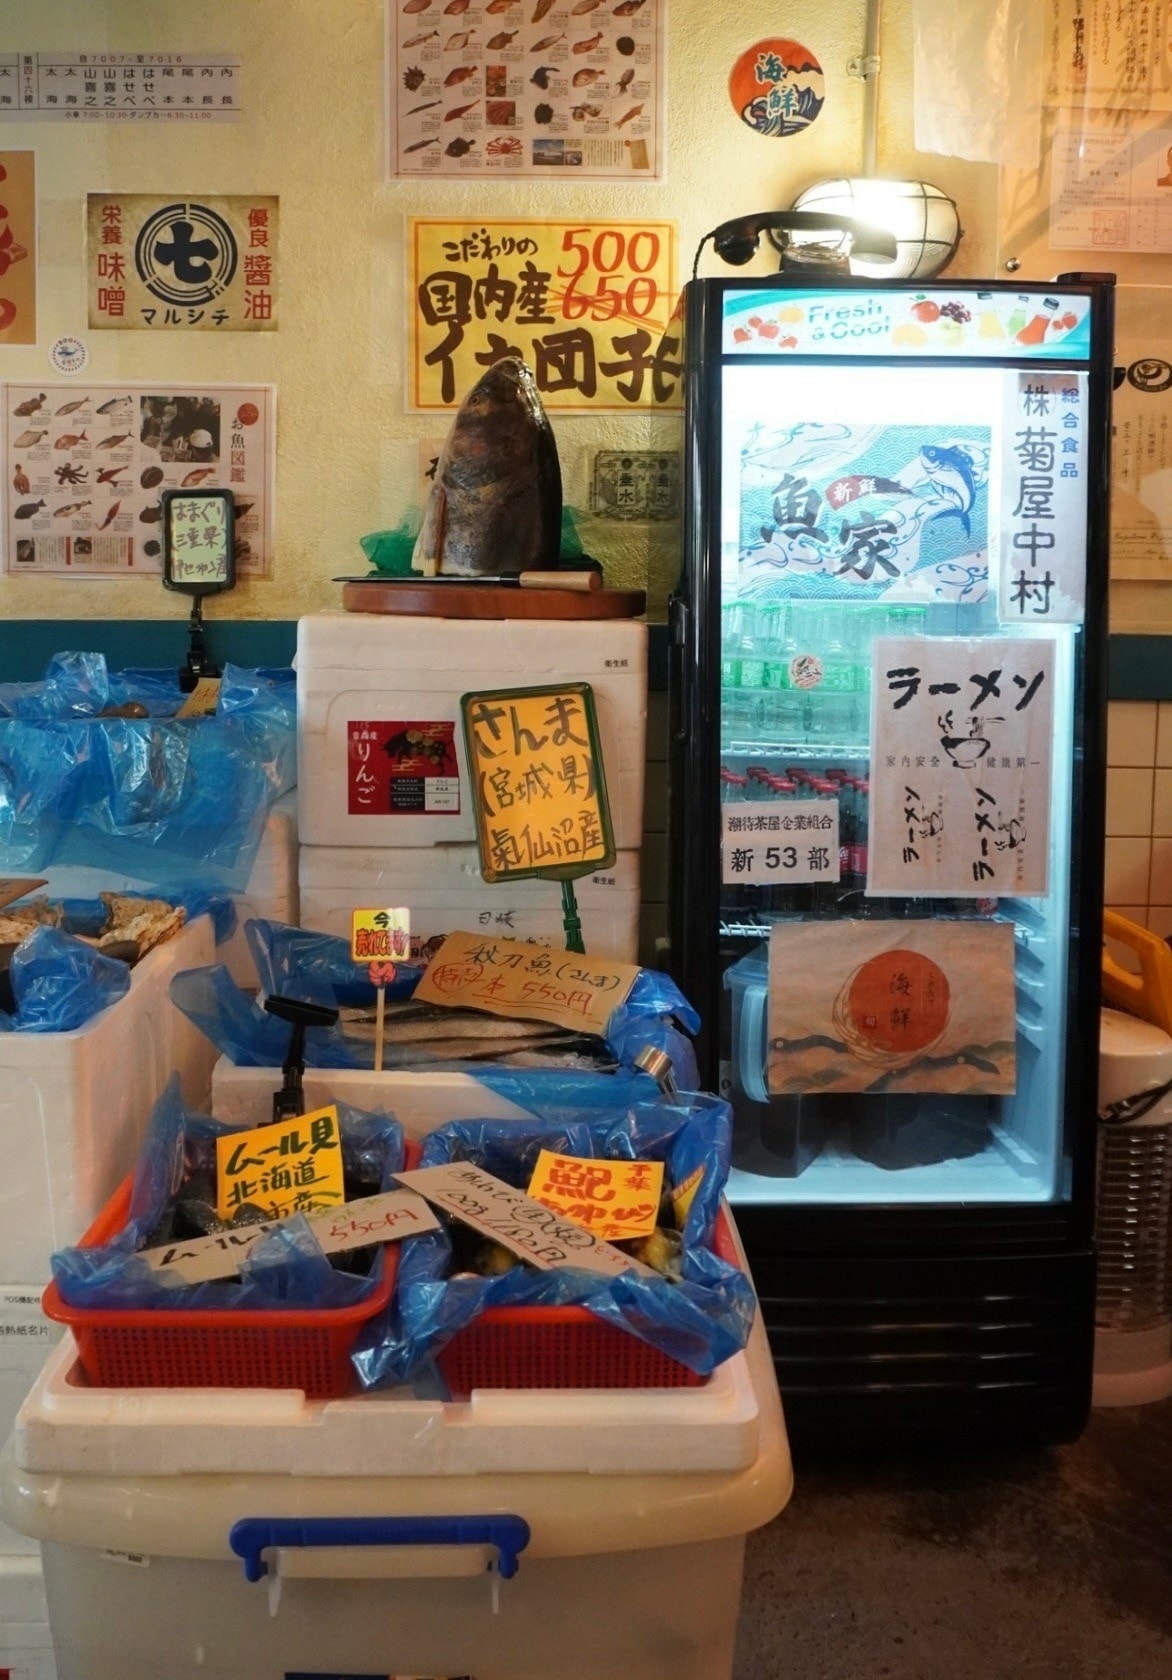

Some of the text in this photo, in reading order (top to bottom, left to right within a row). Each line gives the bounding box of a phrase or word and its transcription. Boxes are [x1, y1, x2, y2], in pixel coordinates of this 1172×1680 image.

[755, 52, 800, 119] 海鮮
[153, 221, 219, 284] 七
[441, 228, 539, 264] こだわりの
[556, 229, 660, 279] 500
[140, 308, 230, 326] マルシチ
[418, 261, 556, 326] 国内産
[809, 299, 882, 323] Fresh
[830, 316, 890, 339] Cool
[230, 418, 246, 482] お魚図鑑
[830, 476, 877, 503] 新鮮
[760, 473, 900, 581] 魚家
[886, 667, 1045, 712] ラーメン
[473, 696, 588, 760] さんま
[355, 742, 376, 804] りんご
[728, 815, 834, 832] 潮待茶屋企業組合
[903, 785, 921, 864] ラーメン
[972, 787, 997, 882] ラーメン
[731, 848, 754, 873] 新
[765, 846, 798, 869] 53
[807, 846, 830, 871] 部
[373, 911, 391, 928] 今
[889, 973, 913, 1031] 海鮮
[225, 1157, 331, 1208] 北海道
